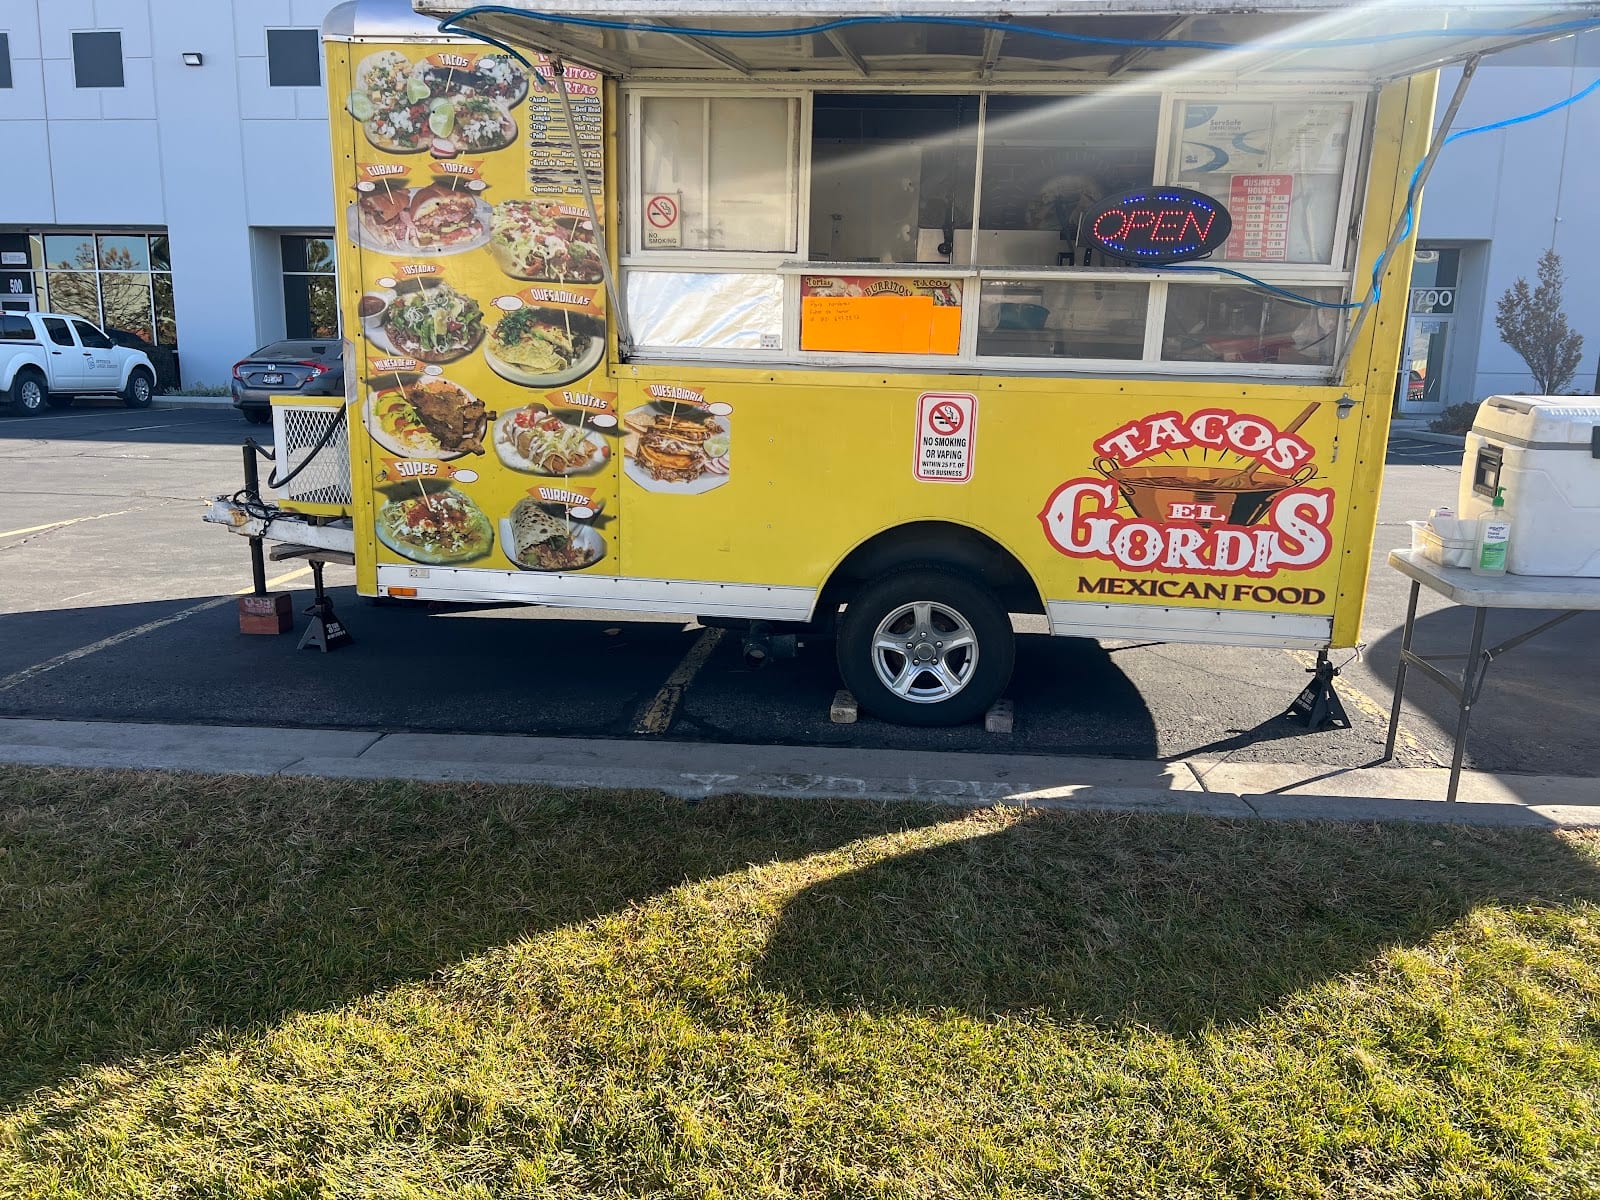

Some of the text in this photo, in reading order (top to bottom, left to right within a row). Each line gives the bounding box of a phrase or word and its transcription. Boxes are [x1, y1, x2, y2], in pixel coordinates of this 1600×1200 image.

[438, 53, 470, 66] TACOS
[535, 65, 597, 80] BURITOS
[366, 165, 404, 176] CUBANA
[440, 162, 474, 174] TORTAS
[1093, 210, 1216, 241] OPEN
[402, 266, 436, 275] TOSTADAS
[10, 279, 22, 294] 500
[864, 280, 912, 296] BURRITOS
[531, 288, 590, 305] QUESADILLAS
[1414, 290, 1452, 306] 700
[562, 391, 608, 409] FLAUTAS
[650, 384, 704, 402] QUESABIRRIA
[923, 437, 966, 447] NO SMOKING
[1096, 411, 1312, 472] TACOS
[926, 450, 962, 459] OR VAPING
[394, 462, 438, 476] SOPES
[538, 488, 590, 505] BURRITOS
[1168, 502, 1226, 522] EL
[1041, 480, 1332, 576] GORDIS
[1077, 576, 1326, 606] MEXICAN FOOD
